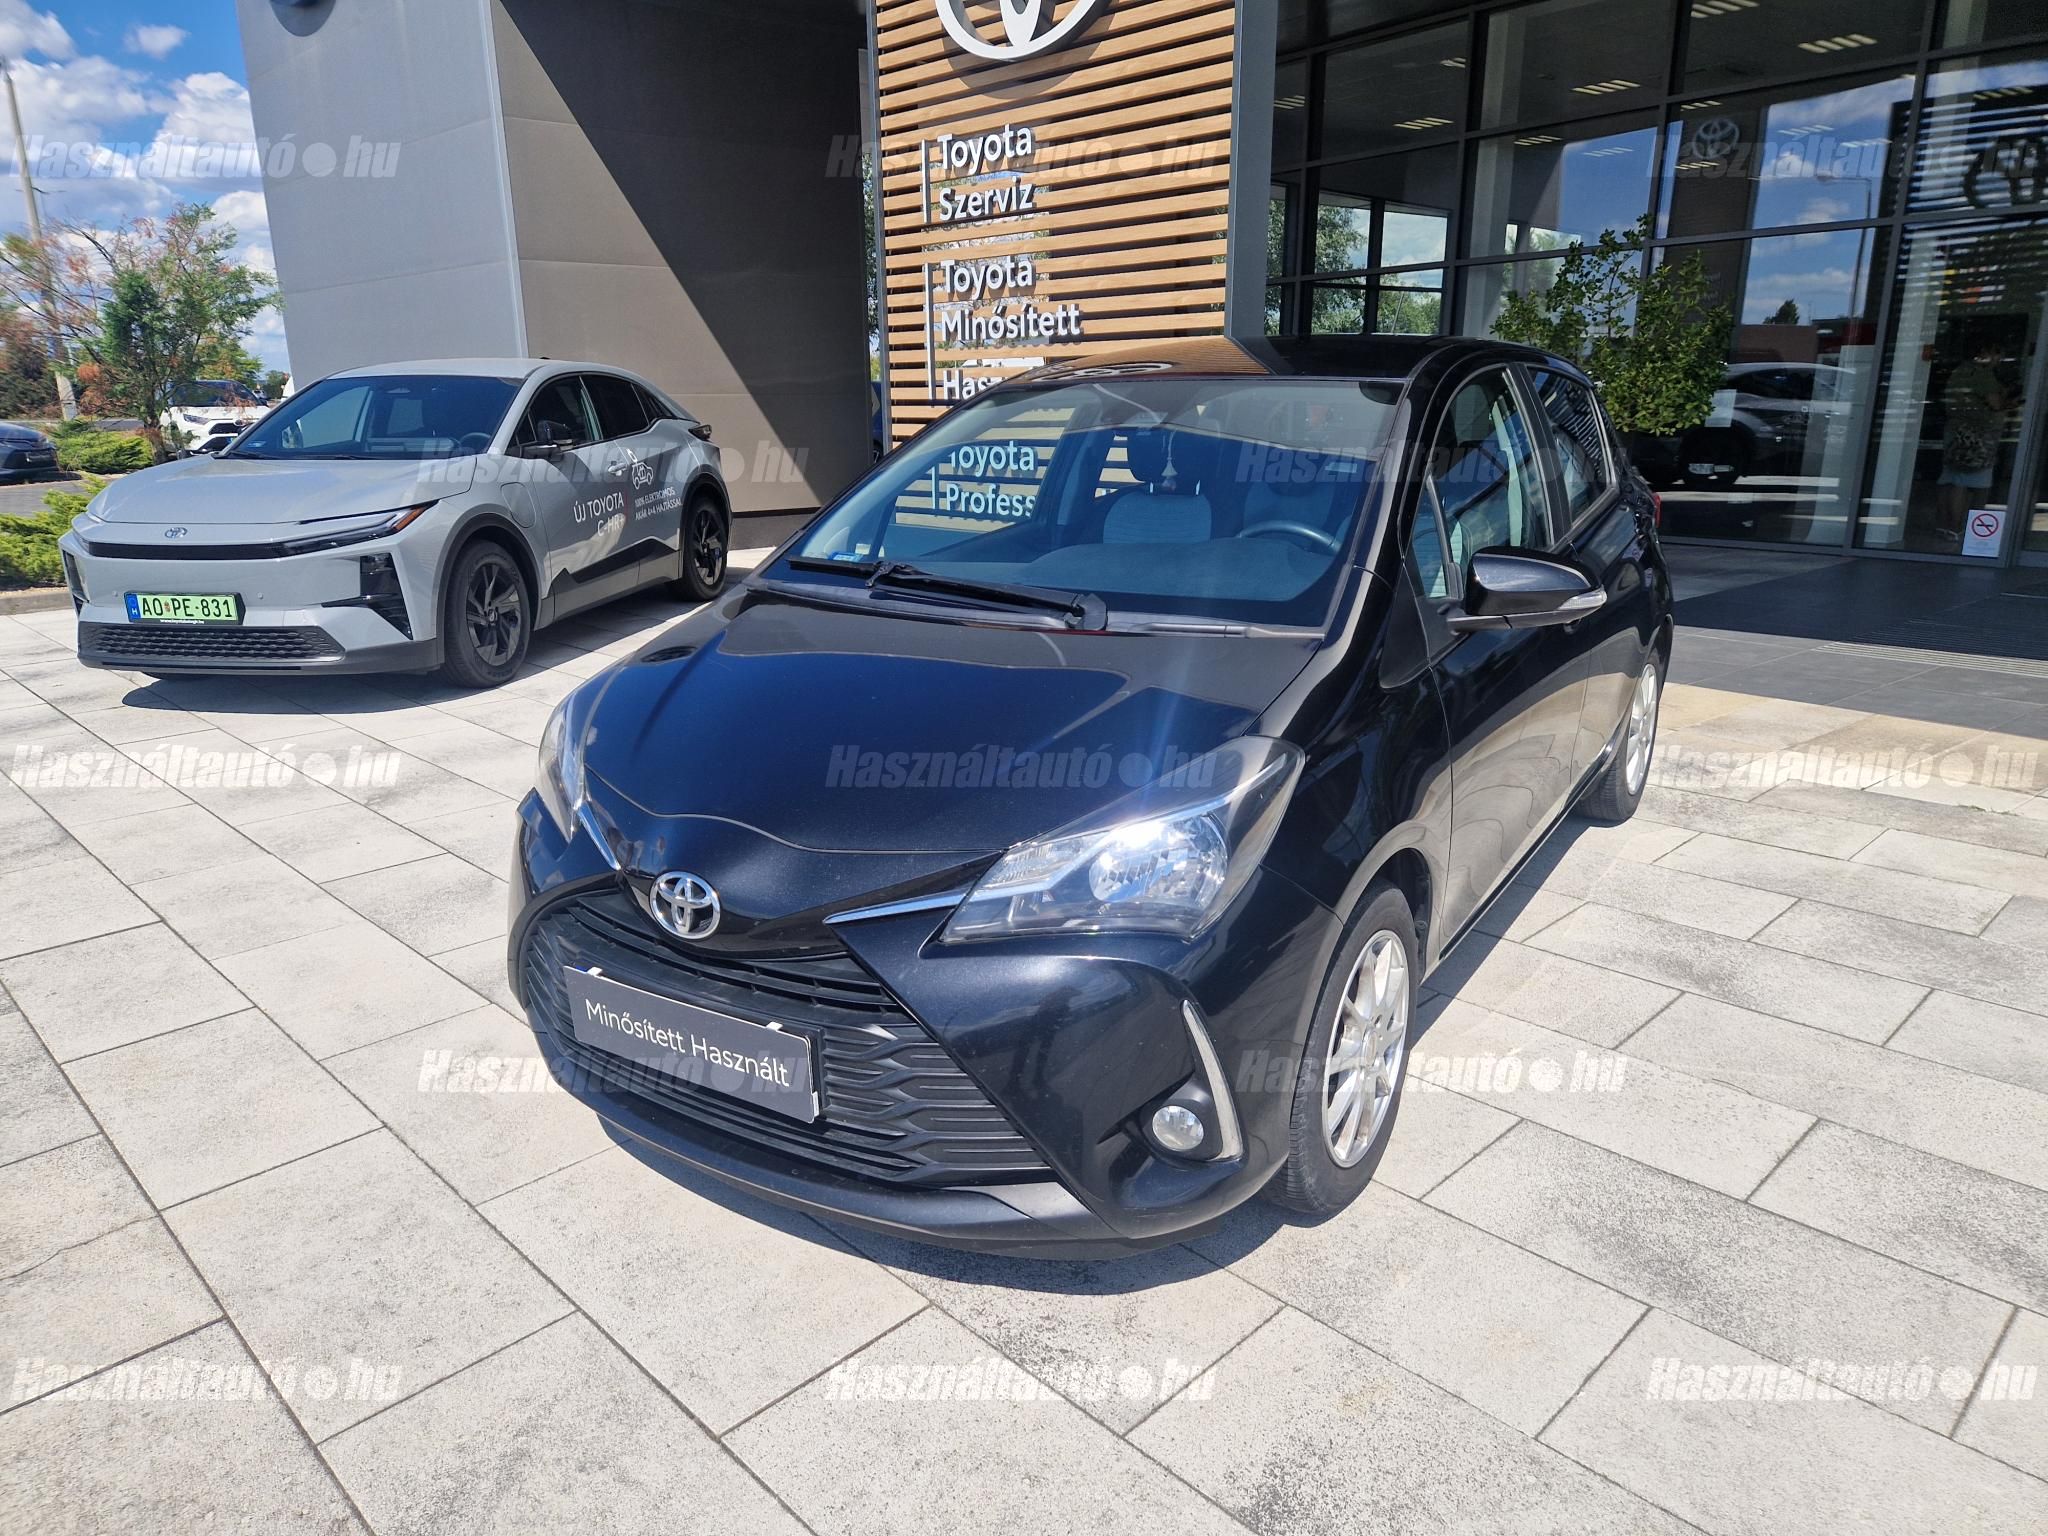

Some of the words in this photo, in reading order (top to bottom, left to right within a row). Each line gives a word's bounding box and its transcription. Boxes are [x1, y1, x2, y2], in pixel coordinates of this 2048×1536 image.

[937, 124, 1034, 174] Toyota
[938, 178, 1036, 221] Szerviz
[939, 255, 1034, 302] Toyota
[940, 303, 1081, 343] Minősített
[573, 499, 586, 523] ÚJ
[588, 492, 624, 517] TOYOTA
[584, 998, 684, 1055] Minősített
[690, 1034, 790, 1087] Használt
